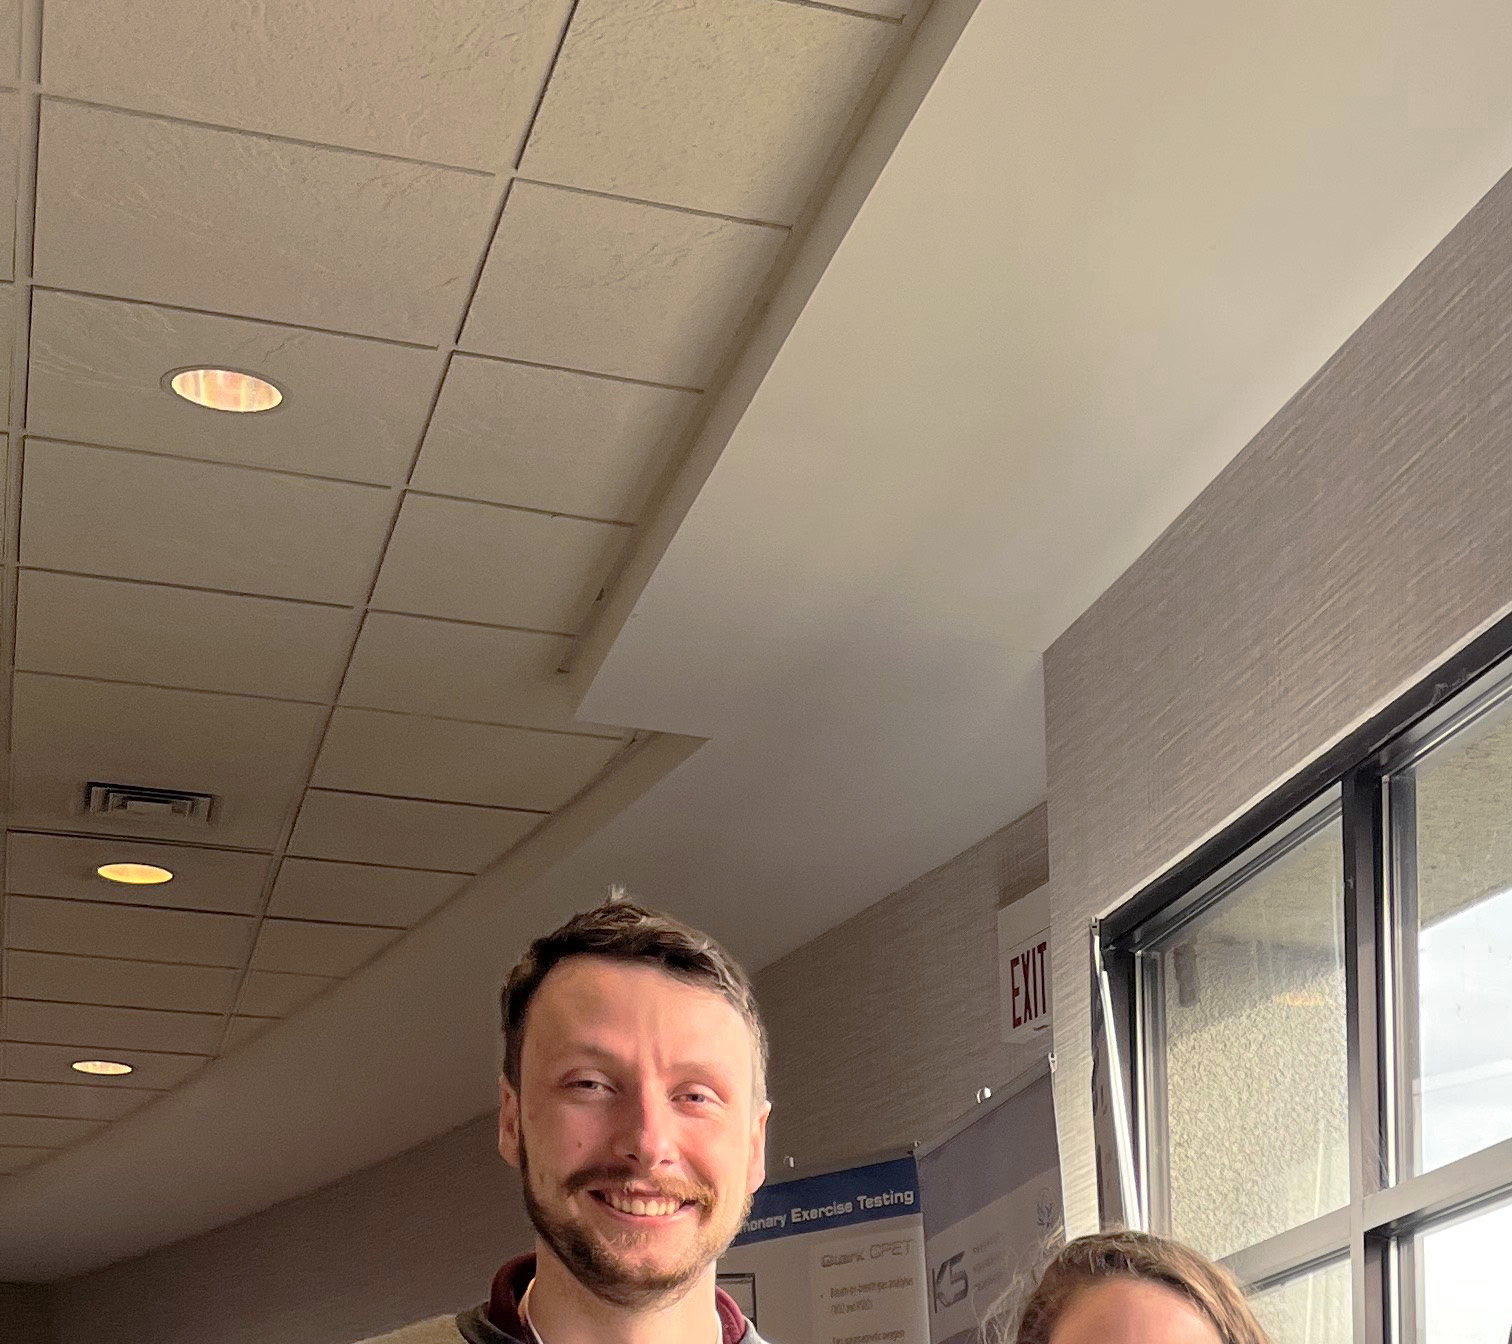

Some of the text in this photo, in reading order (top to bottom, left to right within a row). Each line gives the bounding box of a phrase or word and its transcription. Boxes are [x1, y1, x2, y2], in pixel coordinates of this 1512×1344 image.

[1010, 941, 1047, 1029] EXIT
[791, 1201, 853, 1223] Exercise
[856, 1189, 915, 1211] Testing
